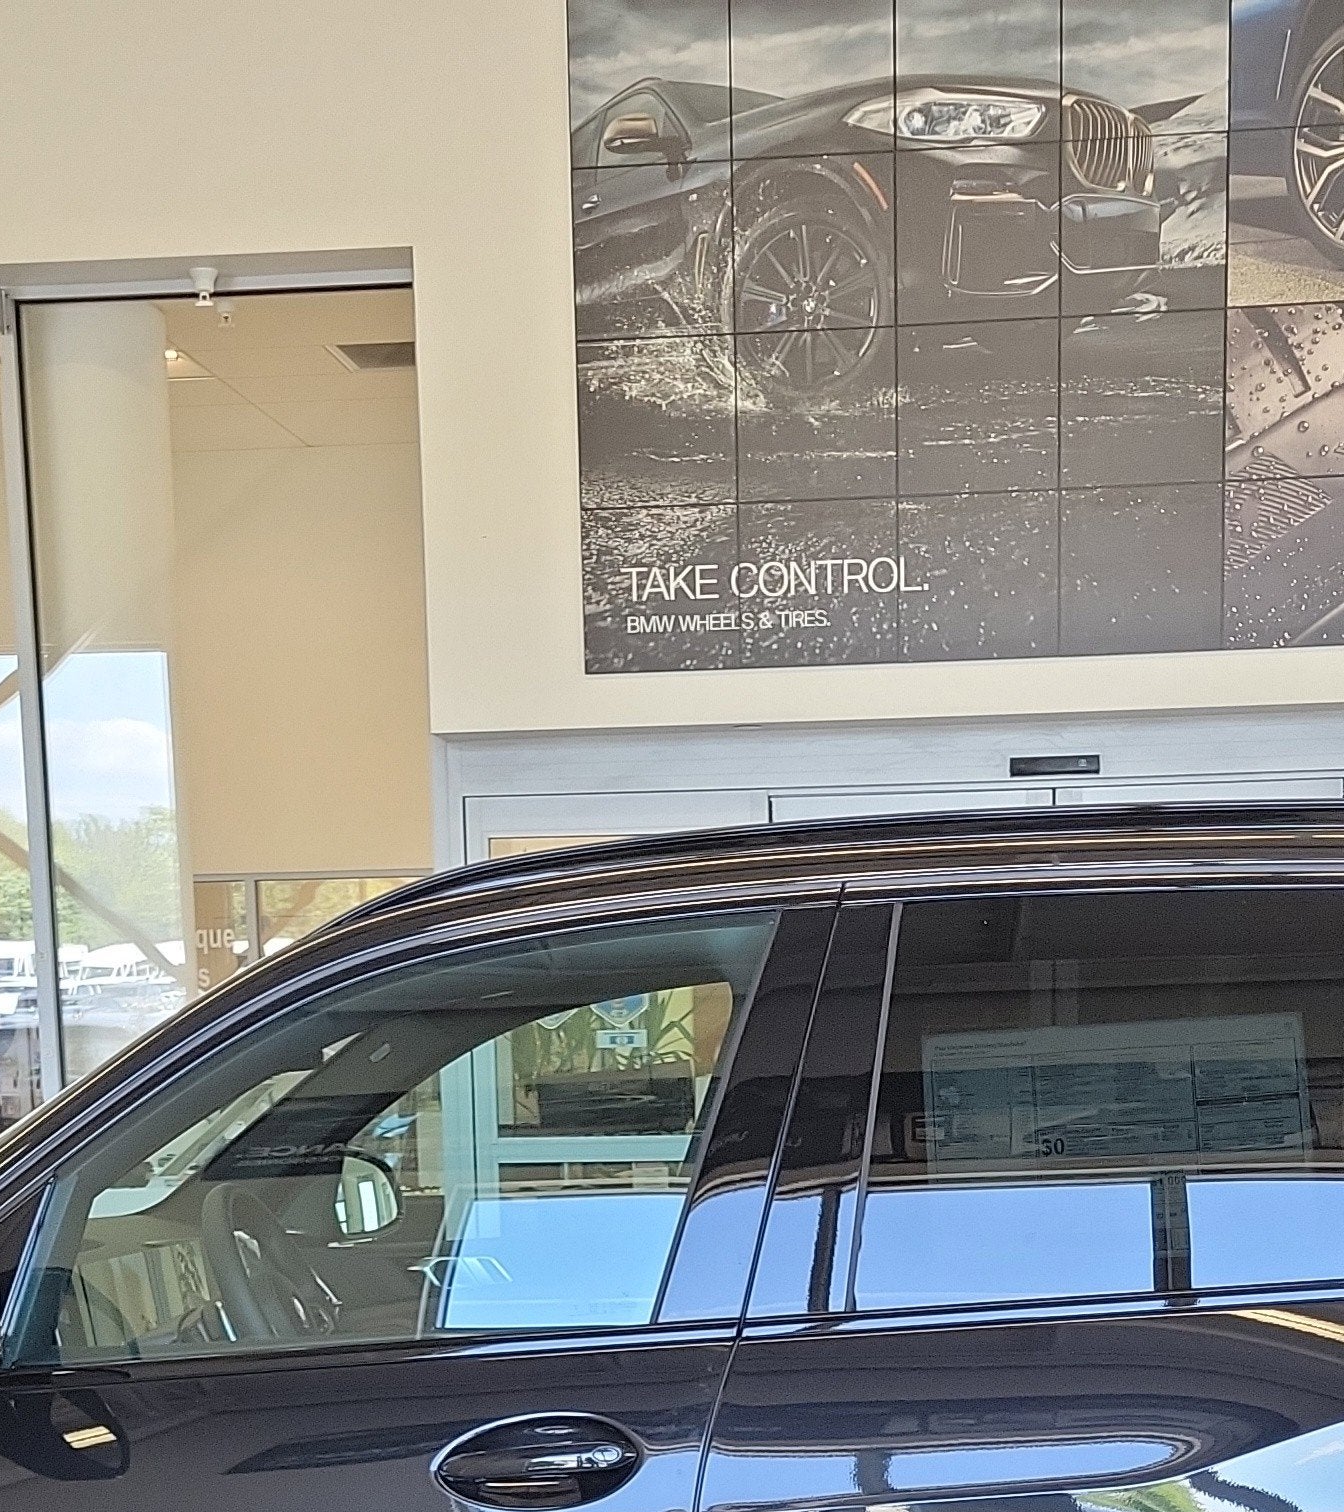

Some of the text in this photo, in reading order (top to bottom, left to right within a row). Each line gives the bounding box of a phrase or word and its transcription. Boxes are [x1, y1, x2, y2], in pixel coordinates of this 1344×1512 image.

[619, 556, 930, 602] TAKE CONTROL.
[626, 609, 832, 634] BMW WHEELS & TIRES.
[196, 928, 235, 955] que
